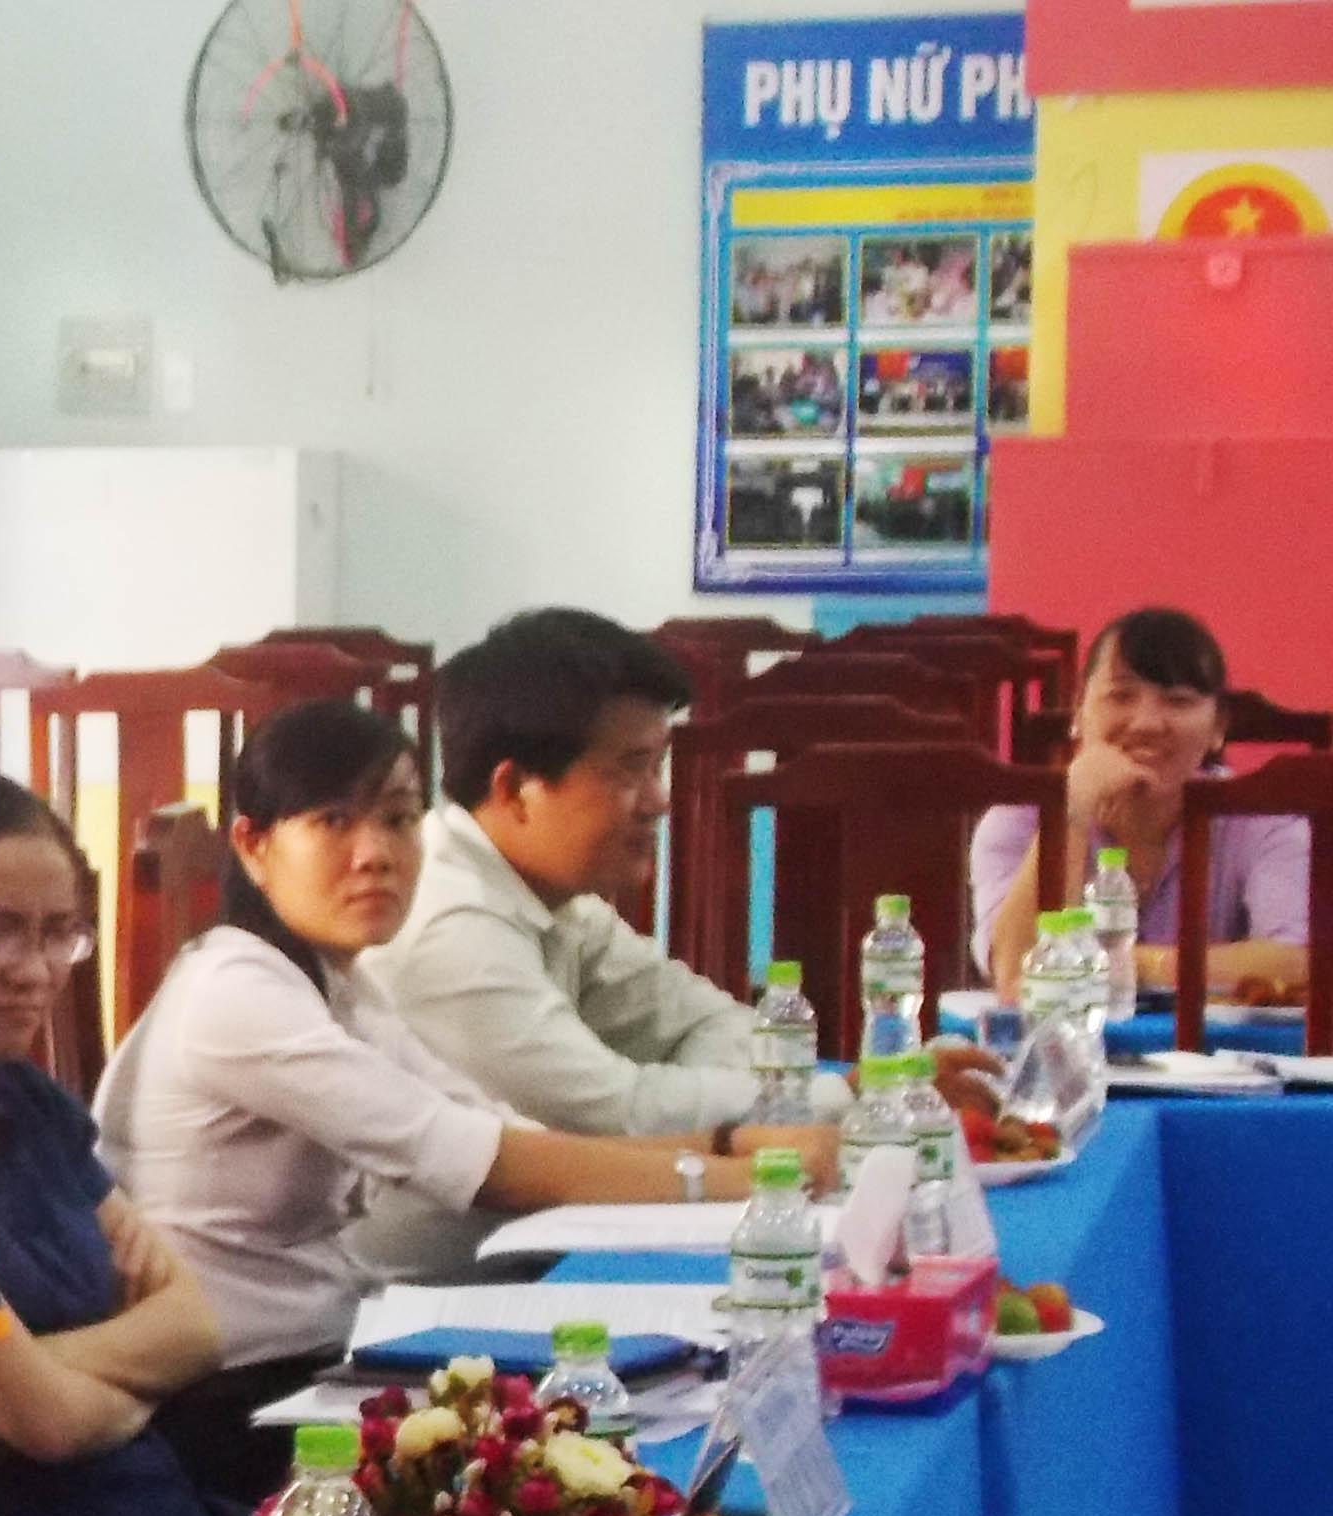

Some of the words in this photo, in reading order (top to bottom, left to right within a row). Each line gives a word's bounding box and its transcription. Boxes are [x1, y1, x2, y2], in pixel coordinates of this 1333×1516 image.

[744, 59, 851, 141] PHỤ
[869, 41, 952, 125] NỮ
[958, 54, 1032, 124] PH
